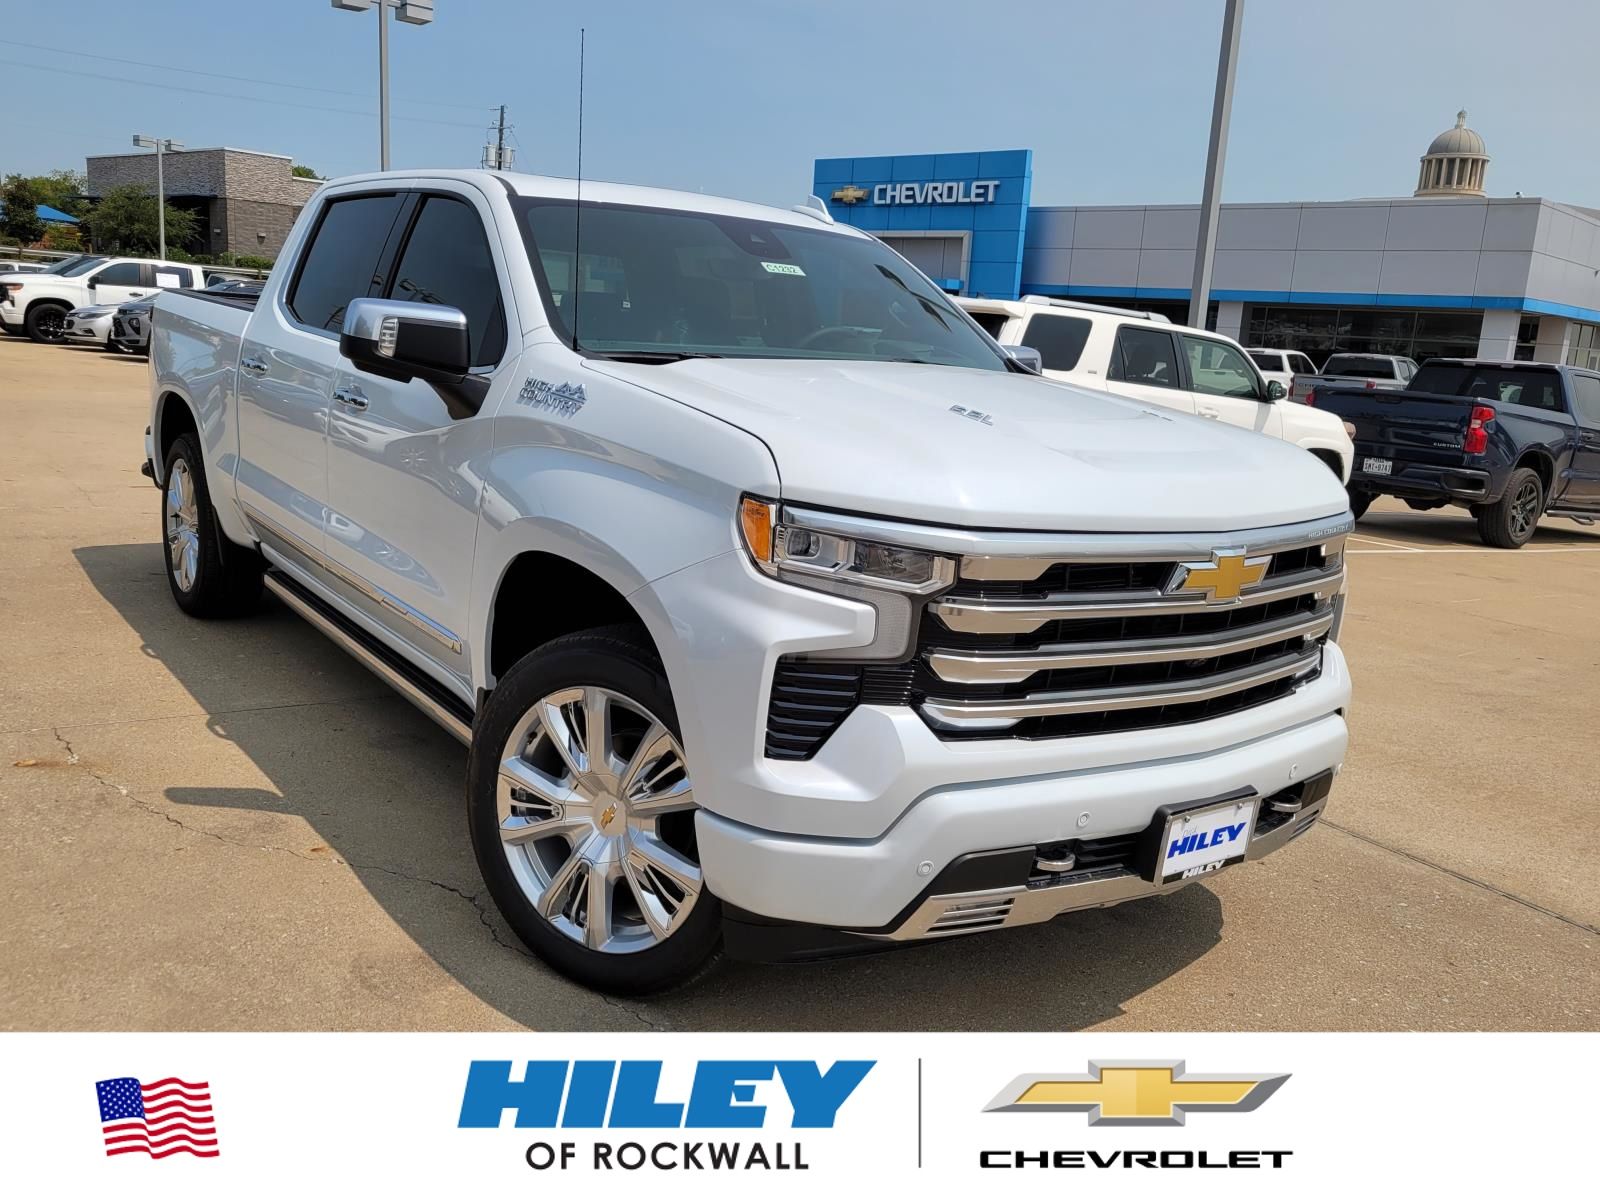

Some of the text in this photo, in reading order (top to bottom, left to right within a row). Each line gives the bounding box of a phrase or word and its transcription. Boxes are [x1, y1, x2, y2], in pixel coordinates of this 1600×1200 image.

[873, 180, 1000, 205] CHEVROLET
[1167, 822, 1247, 859] HILEY
[1181, 860, 1225, 880] HILEY
